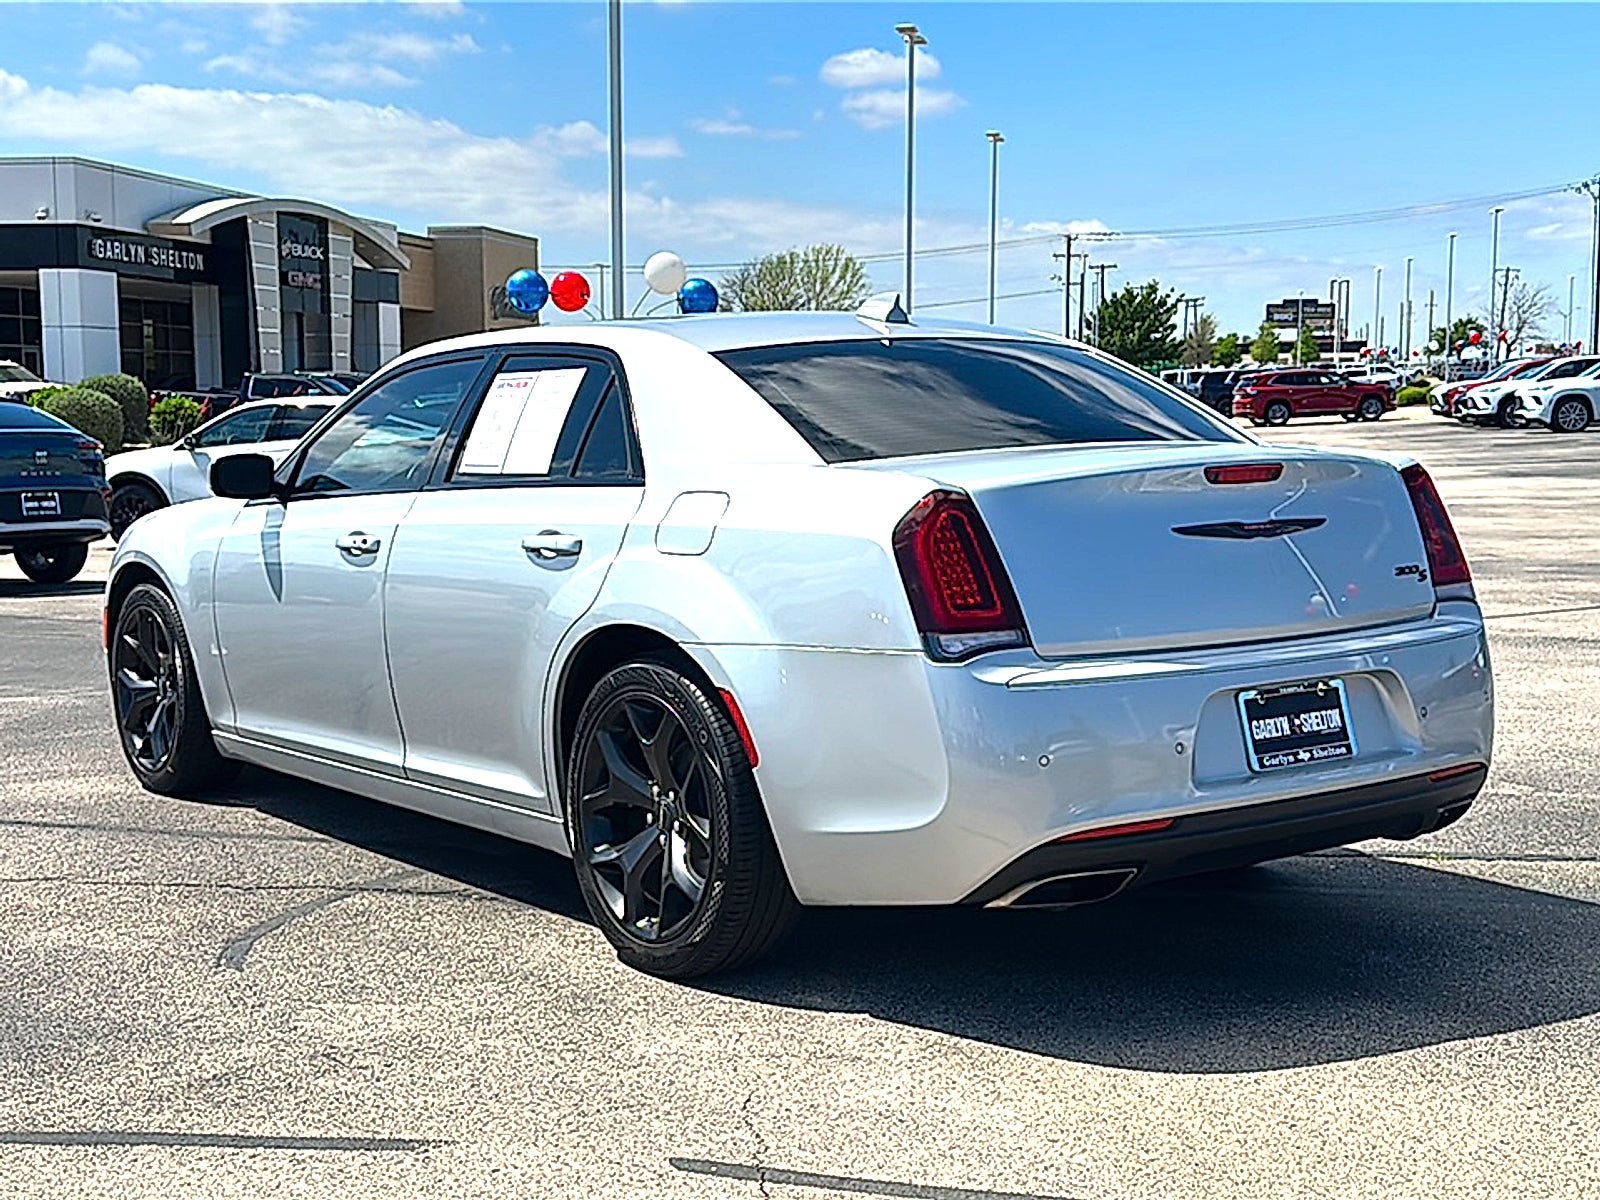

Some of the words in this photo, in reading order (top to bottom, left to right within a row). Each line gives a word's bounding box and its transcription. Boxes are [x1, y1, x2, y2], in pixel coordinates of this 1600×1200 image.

[94, 239, 145, 264] GARLYN
[150, 246, 204, 271] SHELTON
[291, 243, 324, 260] BUICK
[288, 270, 321, 290] GMC
[1251, 716, 1291, 740] GARLYN
[1300, 708, 1342, 733] SHELTON
[1263, 755, 1295, 767] Garlyn
[1312, 746, 1348, 759] Shelton
